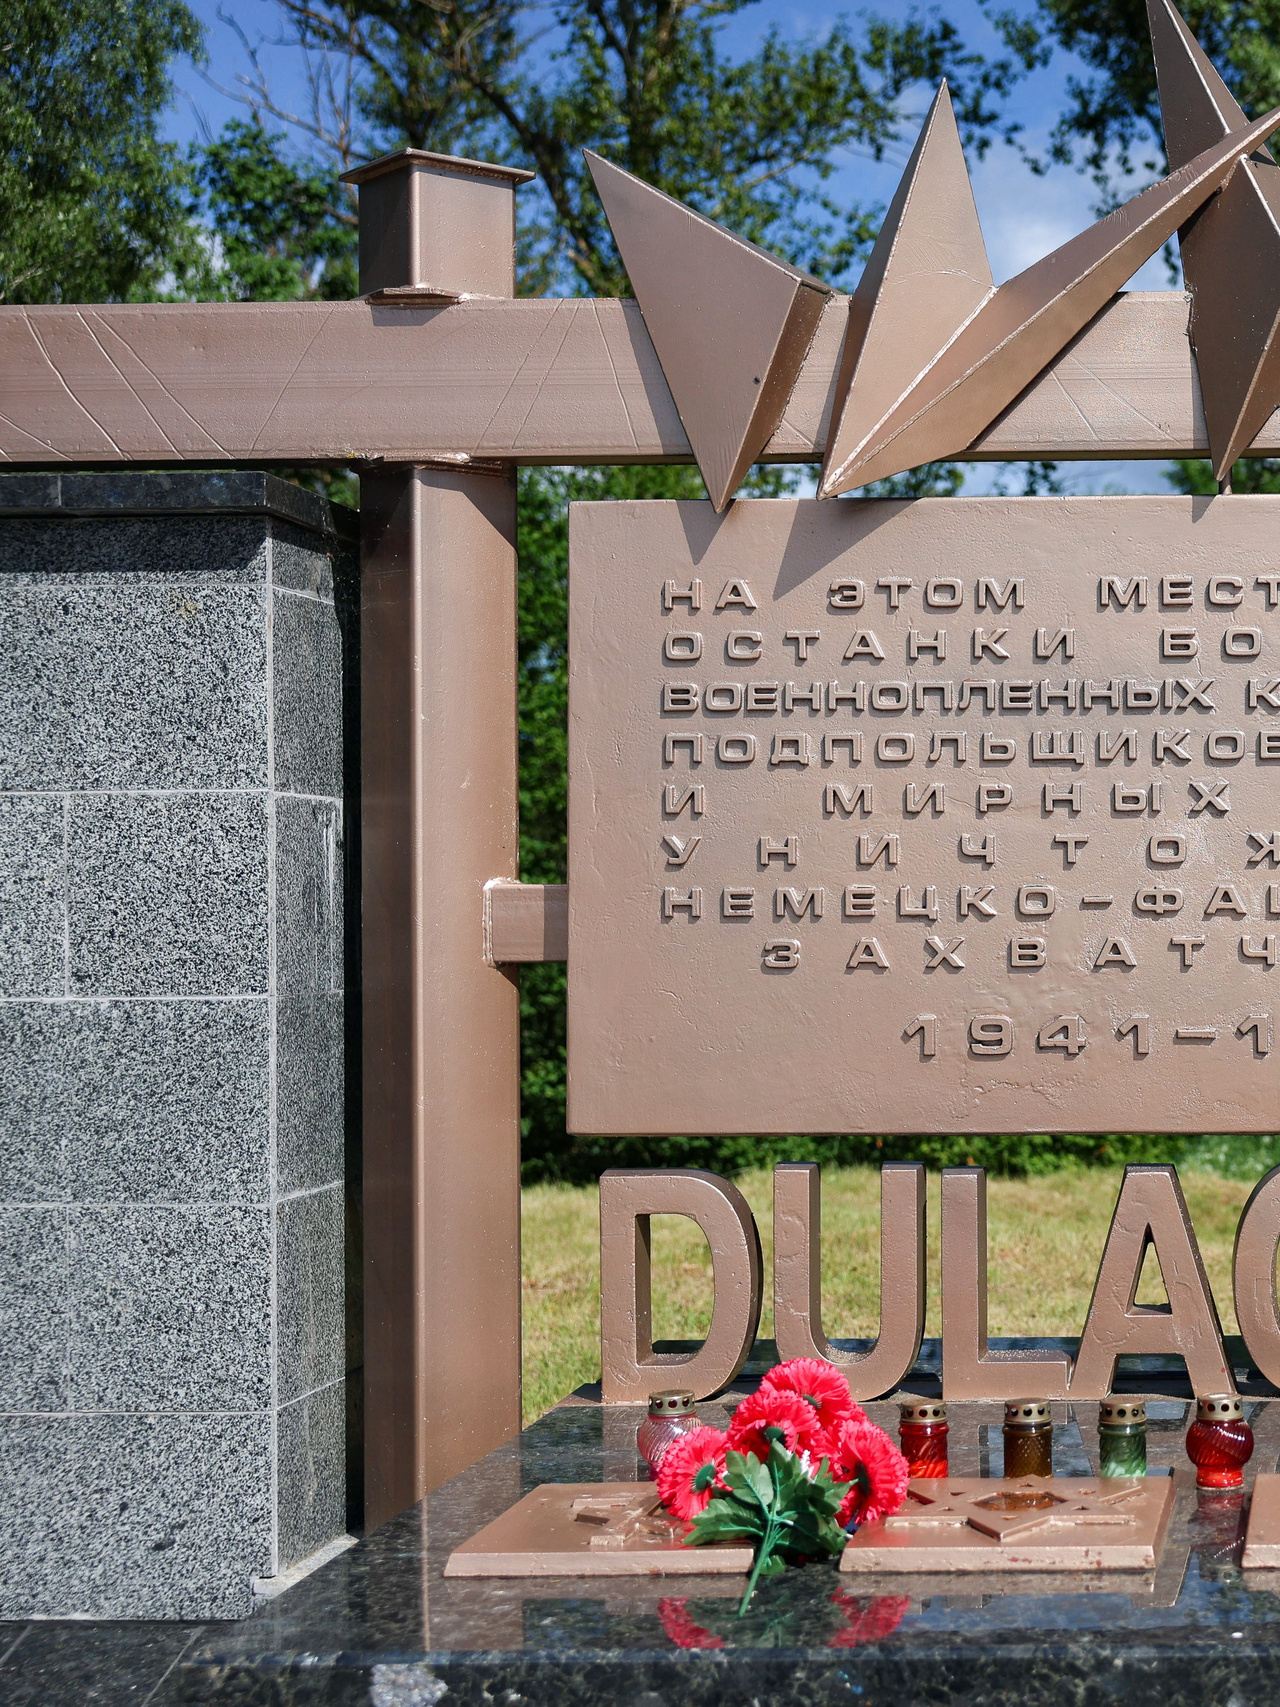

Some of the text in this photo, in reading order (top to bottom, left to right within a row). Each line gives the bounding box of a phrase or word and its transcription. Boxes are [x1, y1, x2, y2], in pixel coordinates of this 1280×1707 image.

[662, 578, 758, 610] НА
[828, 577, 1026, 609] ЭТОМ
[662, 627, 1076, 662] ОСТАНКИ
[661, 678, 1215, 714] ВОЕННОПЛЕННЫХ
[662, 783, 705, 816] И
[824, 780, 1230, 816] МИРНЫХ
